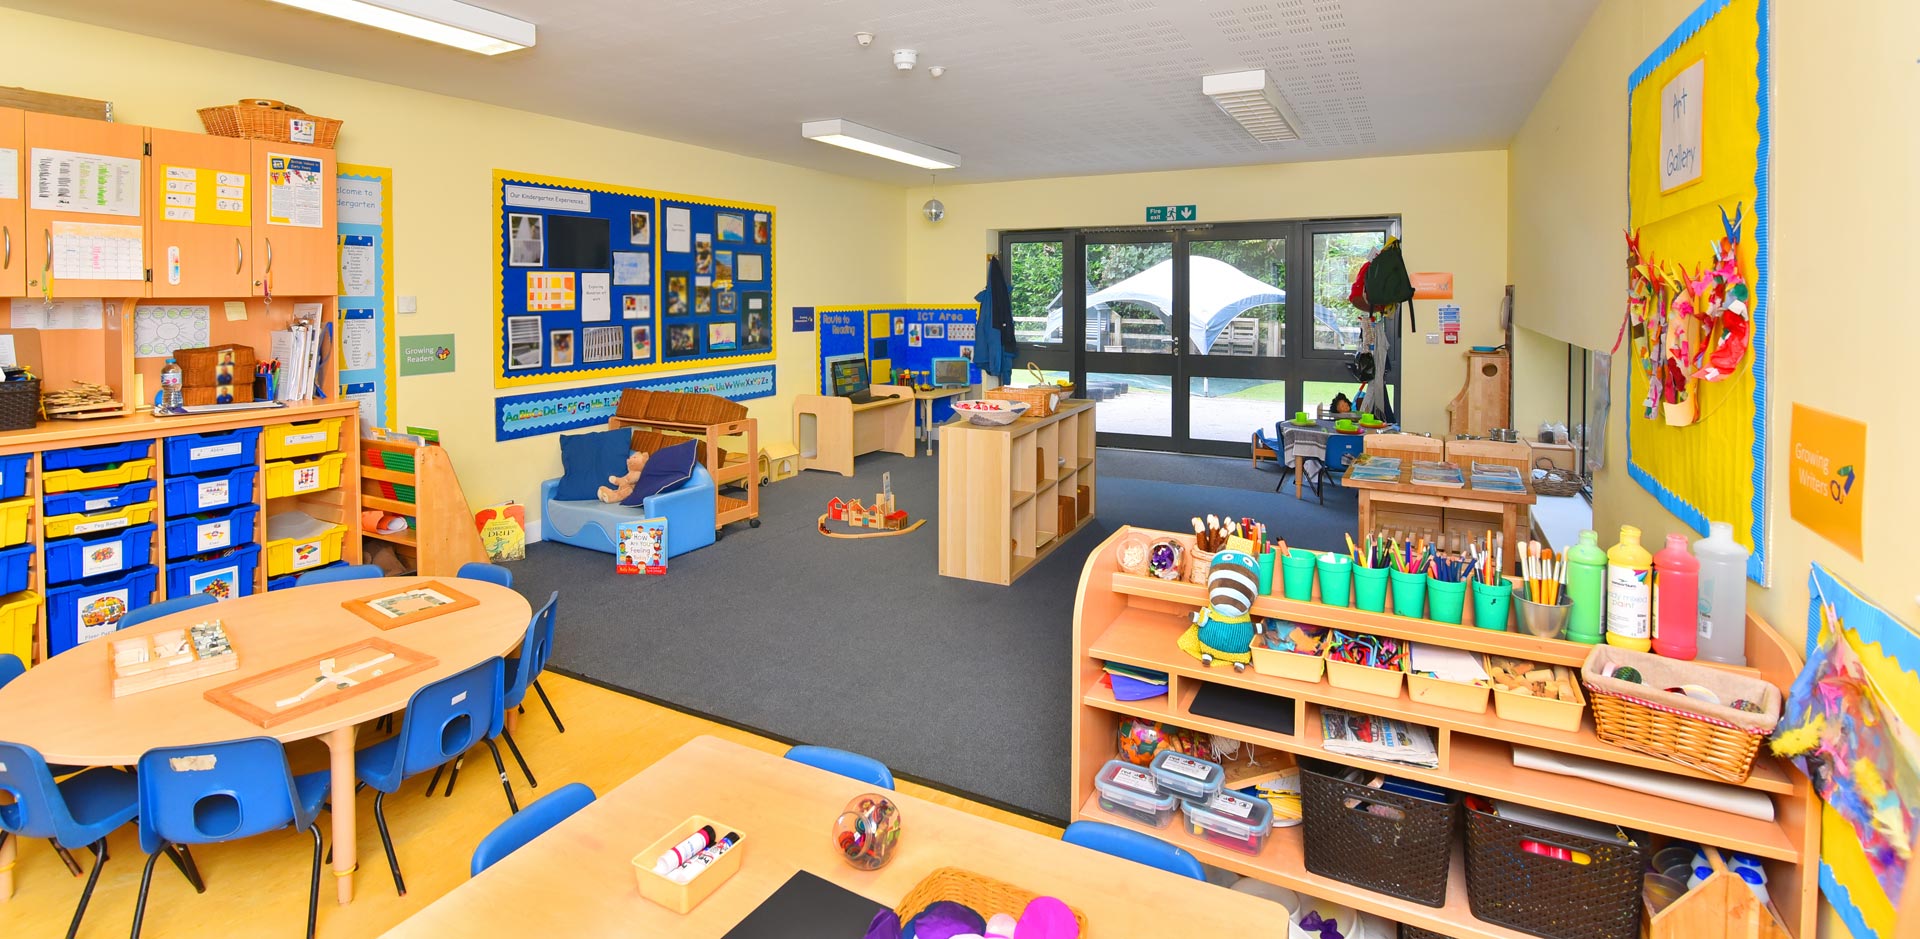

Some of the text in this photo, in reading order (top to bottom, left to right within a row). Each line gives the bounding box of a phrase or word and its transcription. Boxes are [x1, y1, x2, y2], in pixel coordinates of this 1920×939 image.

[1672, 88, 1688, 123] Art
[1666, 144, 1696, 177] Gallery
[337, 186, 363, 195] elcome
[522, 193, 554, 202] Kindergarten
[823, 313, 851, 324] Route to
[917, 311, 963, 321] ICT Area
[832, 325, 855, 336] Reading
[405, 346, 434, 355] Growing
[543, 405, 556, 416] Dd
[557, 403, 567, 413] Ee
[577, 401, 591, 413] Gg
[1795, 442, 1830, 476] Growing
[1799, 467, 1829, 497] Writers
[634, 533, 648, 541] How
[1612, 600, 1634, 609] paint
